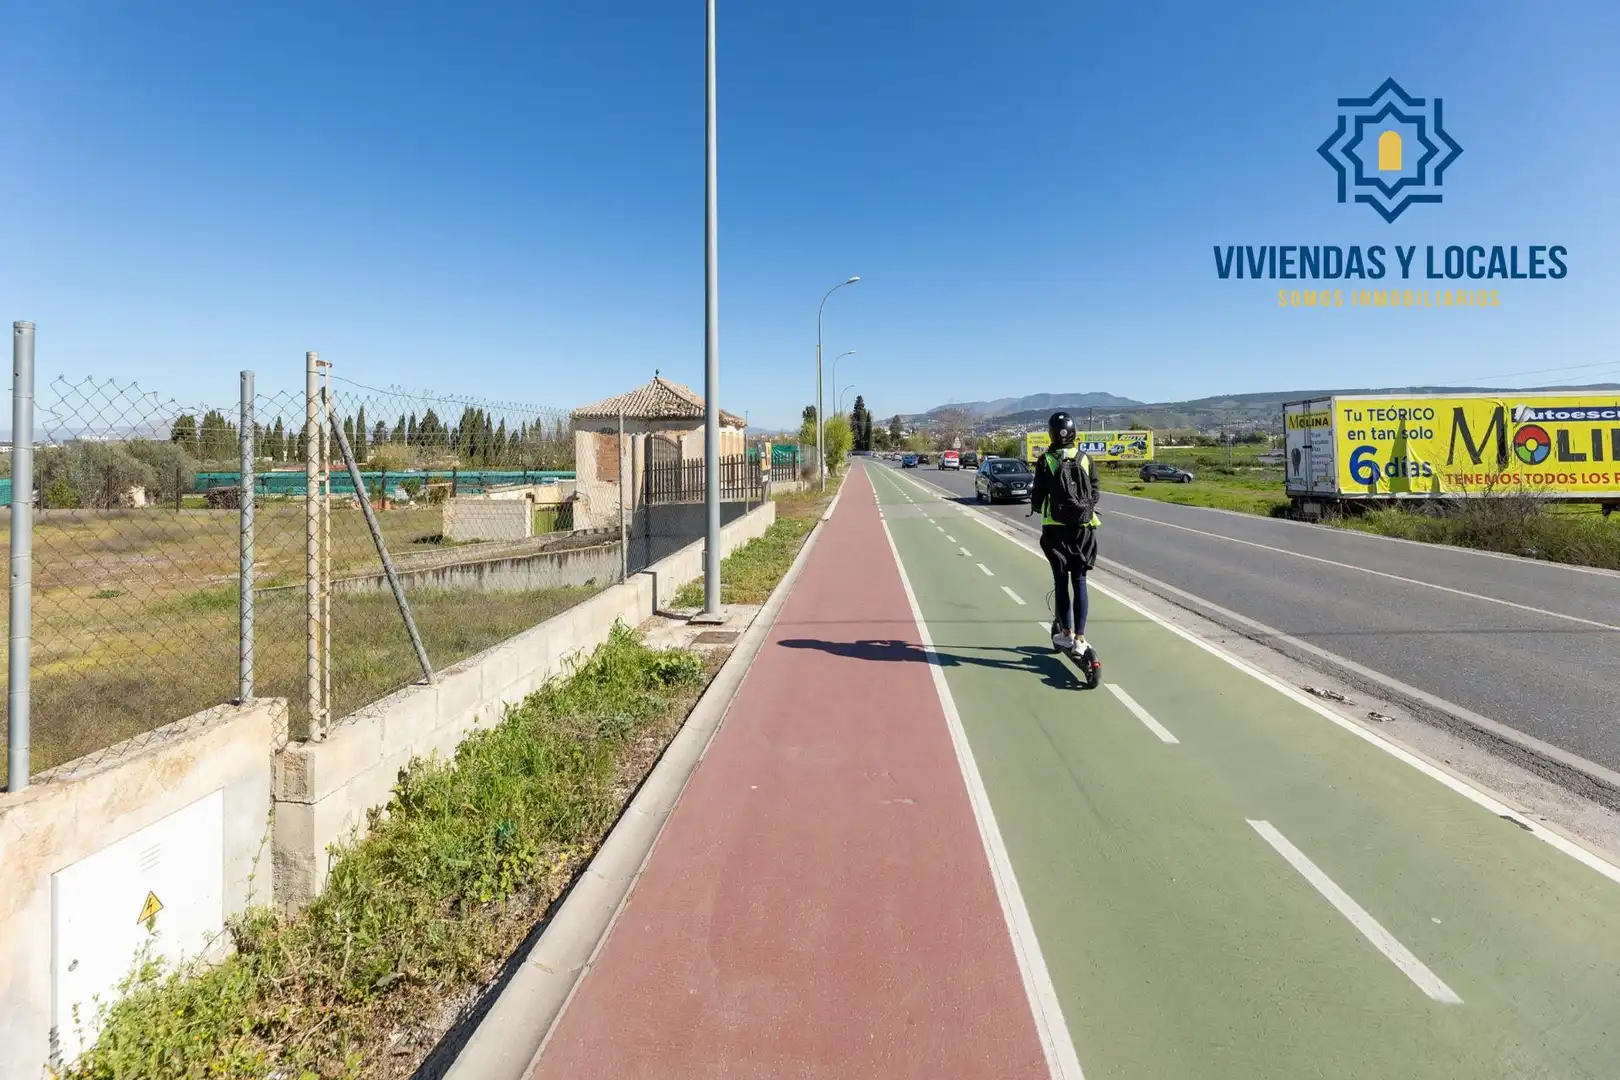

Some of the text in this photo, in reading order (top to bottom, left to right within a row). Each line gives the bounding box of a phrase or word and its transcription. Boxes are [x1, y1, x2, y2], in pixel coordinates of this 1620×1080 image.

[1344, 409, 1362, 421] Tu
[1366, 404, 1435, 421] TEÓRICO
[1514, 407, 1620, 422] utoesc
[1288, 415, 1329, 429] MOLINA
[1347, 425, 1434, 440] en tan solo
[1349, 445, 1382, 485] 6
[1384, 456, 1433, 478] días
[1445, 473, 1520, 485] TENEMOS
[1524, 473, 1577, 485] TODOS
[1581, 473, 1611, 485] LOS
